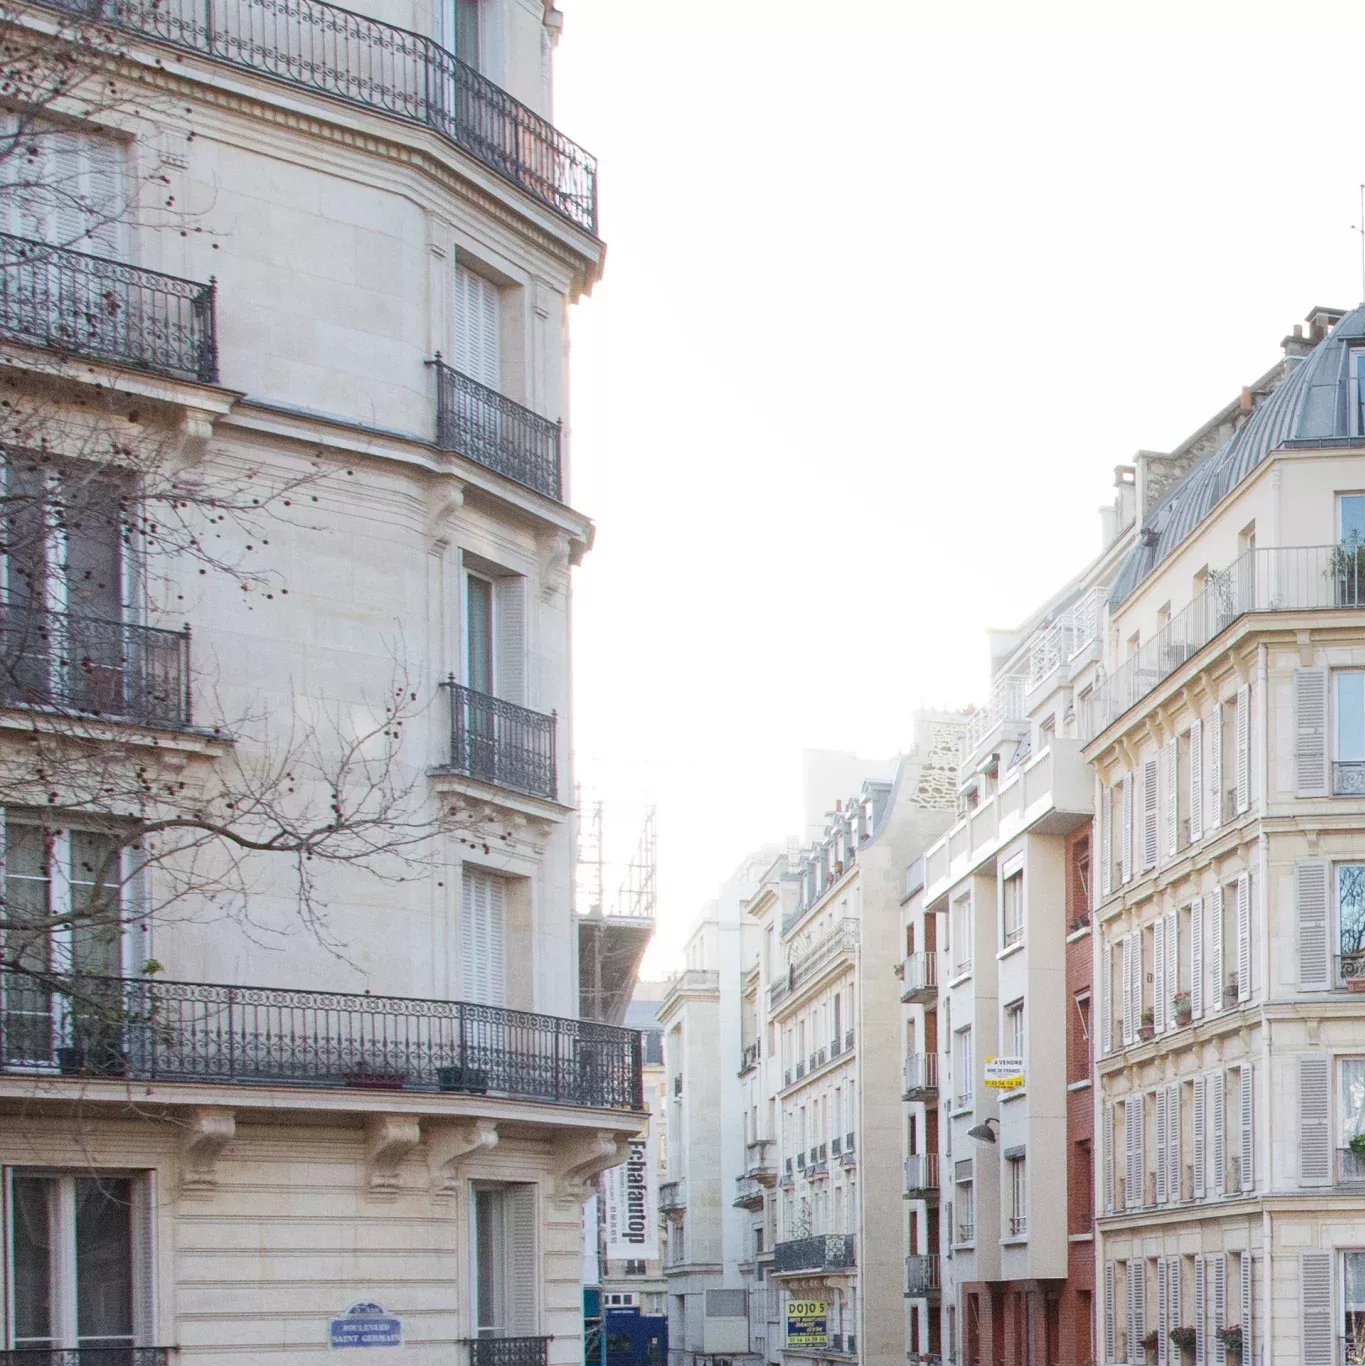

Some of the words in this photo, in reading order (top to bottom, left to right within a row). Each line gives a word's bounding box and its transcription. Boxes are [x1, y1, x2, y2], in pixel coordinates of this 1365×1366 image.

[622, 1139, 646, 1244] Echafautop
[789, 1303, 816, 1315] DOJO
[820, 1303, 825, 1313] 5
[343, 1324, 390, 1332] BOULEVARD
[332, 1335, 359, 1343] SAINT
[361, 1335, 401, 1343] GERMAIN
